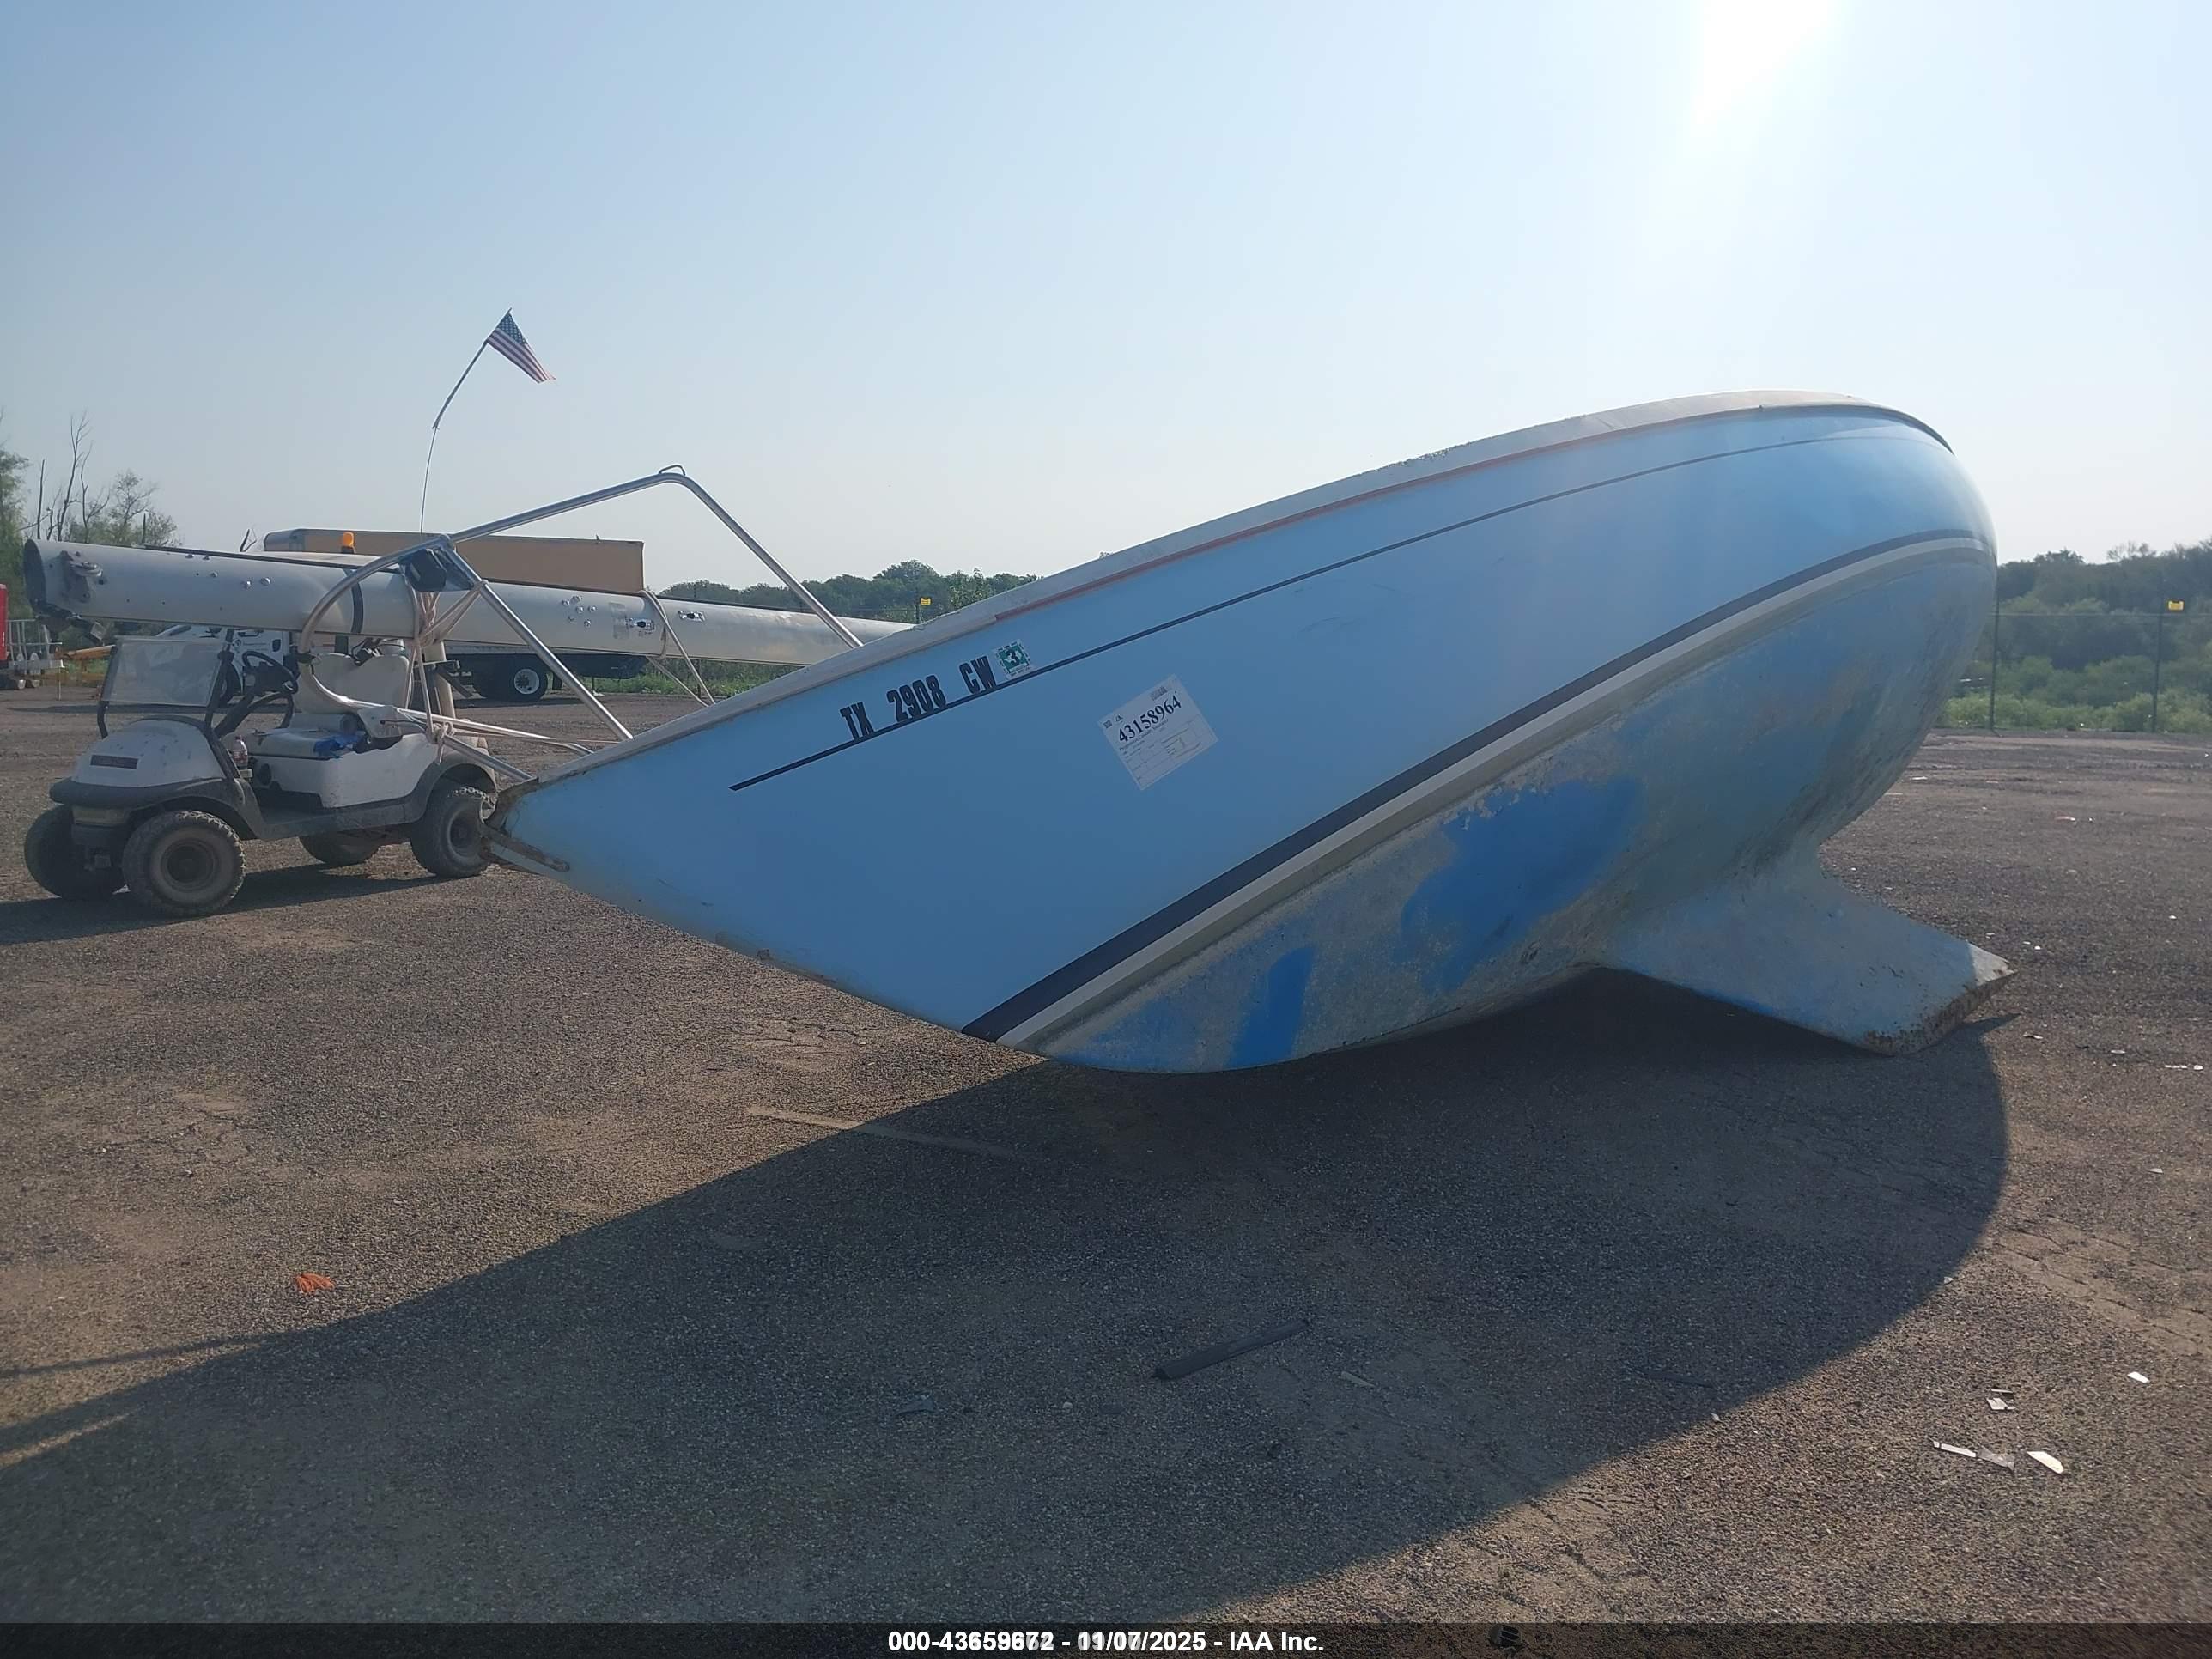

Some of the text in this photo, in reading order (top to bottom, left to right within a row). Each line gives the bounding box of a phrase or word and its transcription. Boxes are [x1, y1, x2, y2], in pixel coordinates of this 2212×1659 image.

[840, 655, 997, 740] TX 2908 CW
[1119, 695, 1182, 742] 43158964
